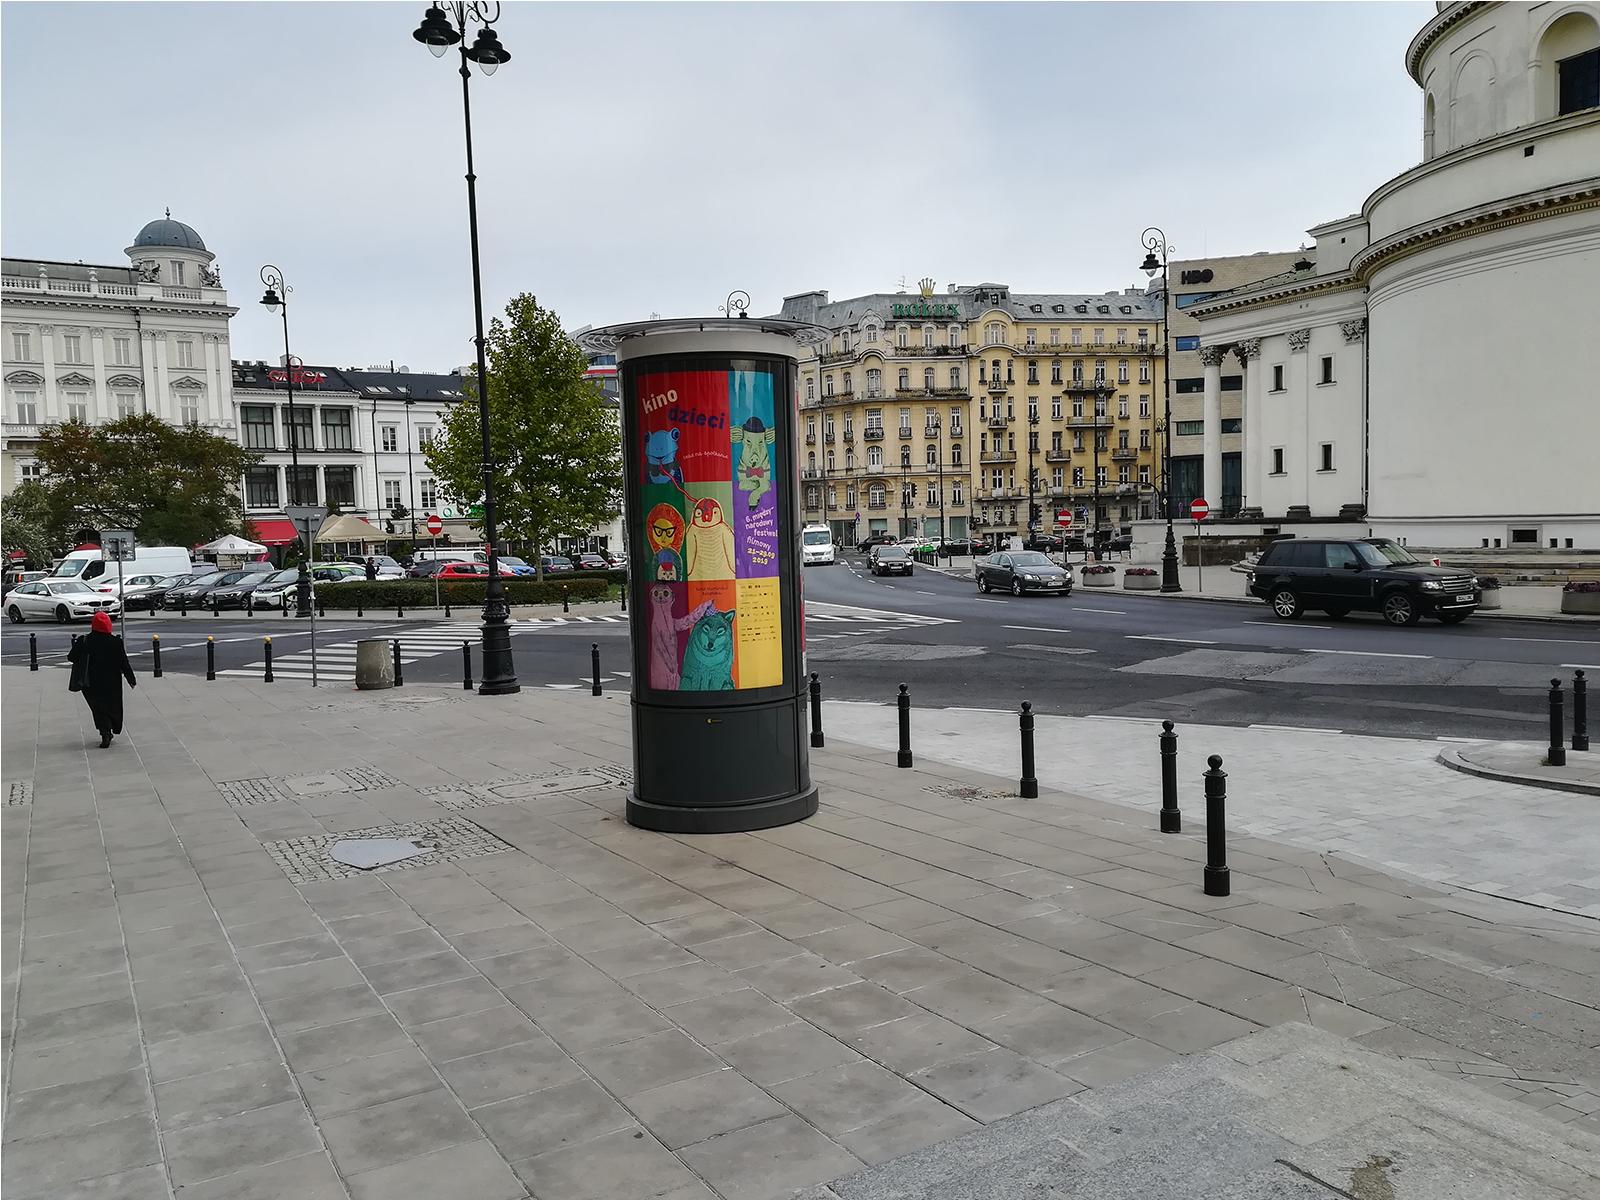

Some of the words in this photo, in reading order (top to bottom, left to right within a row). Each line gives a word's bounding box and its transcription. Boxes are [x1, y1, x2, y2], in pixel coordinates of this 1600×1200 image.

[1181, 269, 1214, 285] HBO
[892, 303, 961, 318] ROLEX
[641, 389, 678, 415] kino
[668, 406, 726, 430] dzieci
[745, 519, 774, 530] narodowy
[753, 528, 779, 537] festiwal
[746, 535, 772, 551] filmowy
